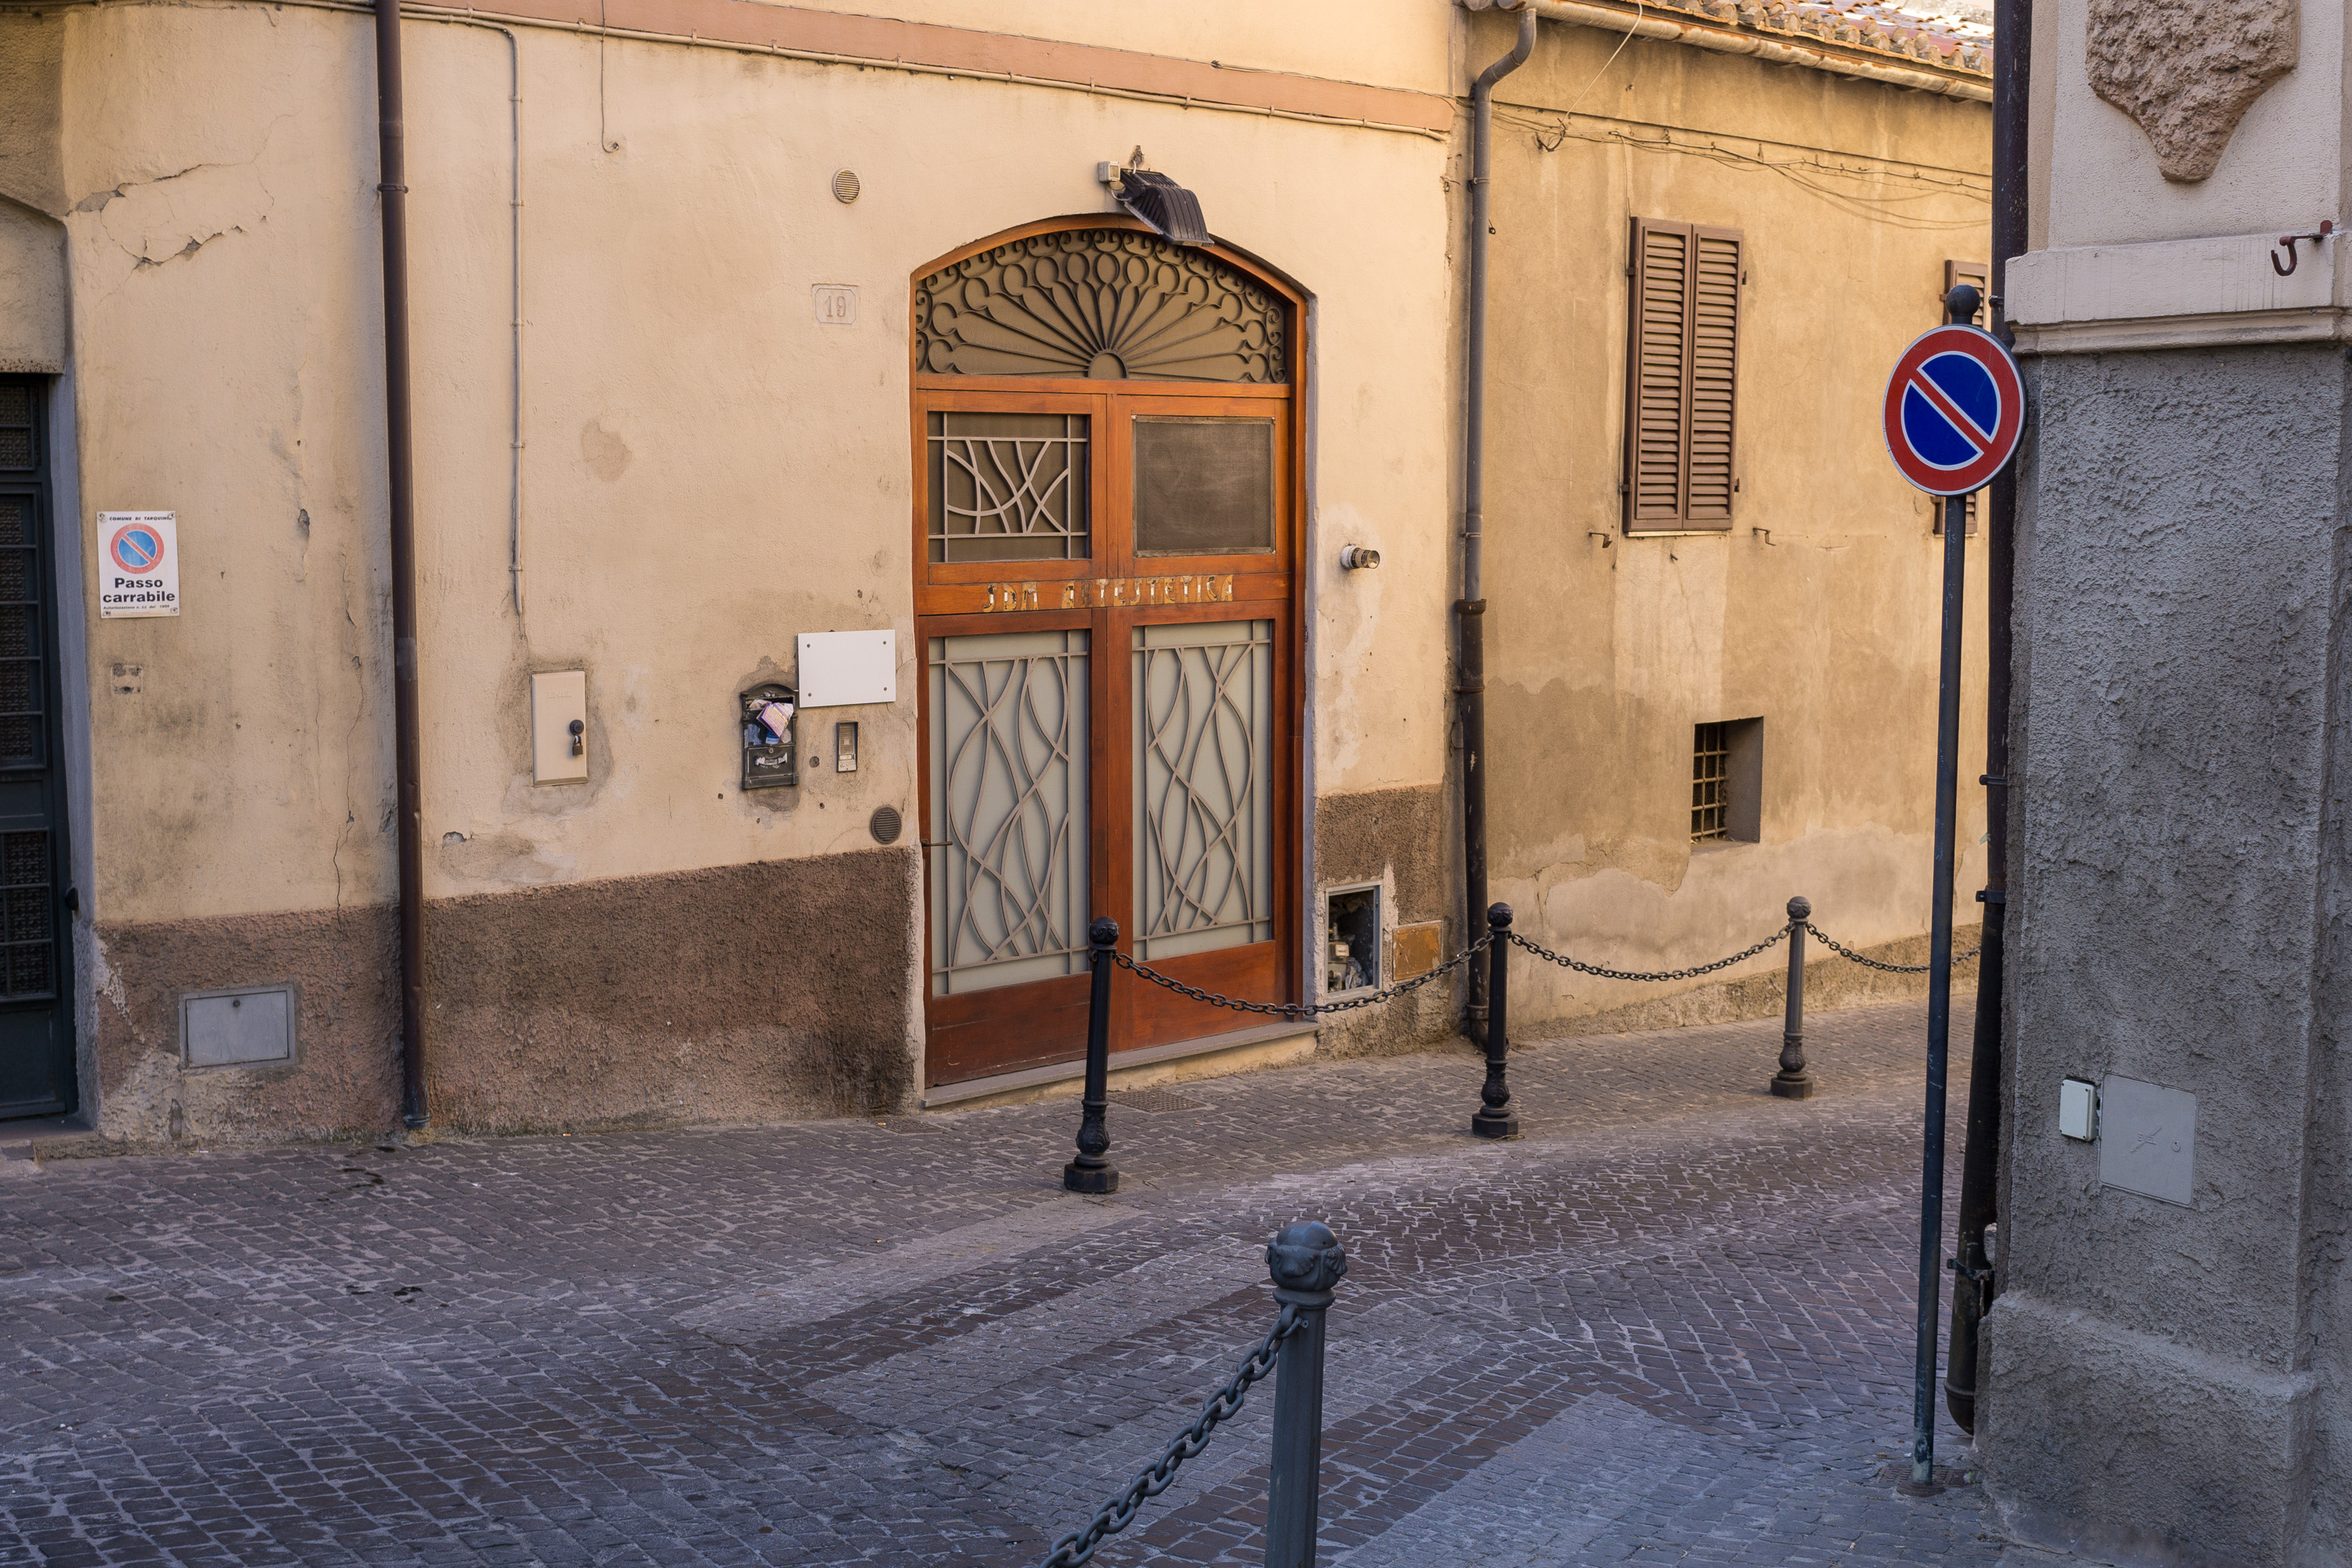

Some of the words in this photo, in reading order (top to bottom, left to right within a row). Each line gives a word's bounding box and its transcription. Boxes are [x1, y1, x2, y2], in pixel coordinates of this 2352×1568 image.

[826, 295, 847, 318] 19
[114, 578, 163, 588] Passo
[103, 591, 176, 603] carrabile
